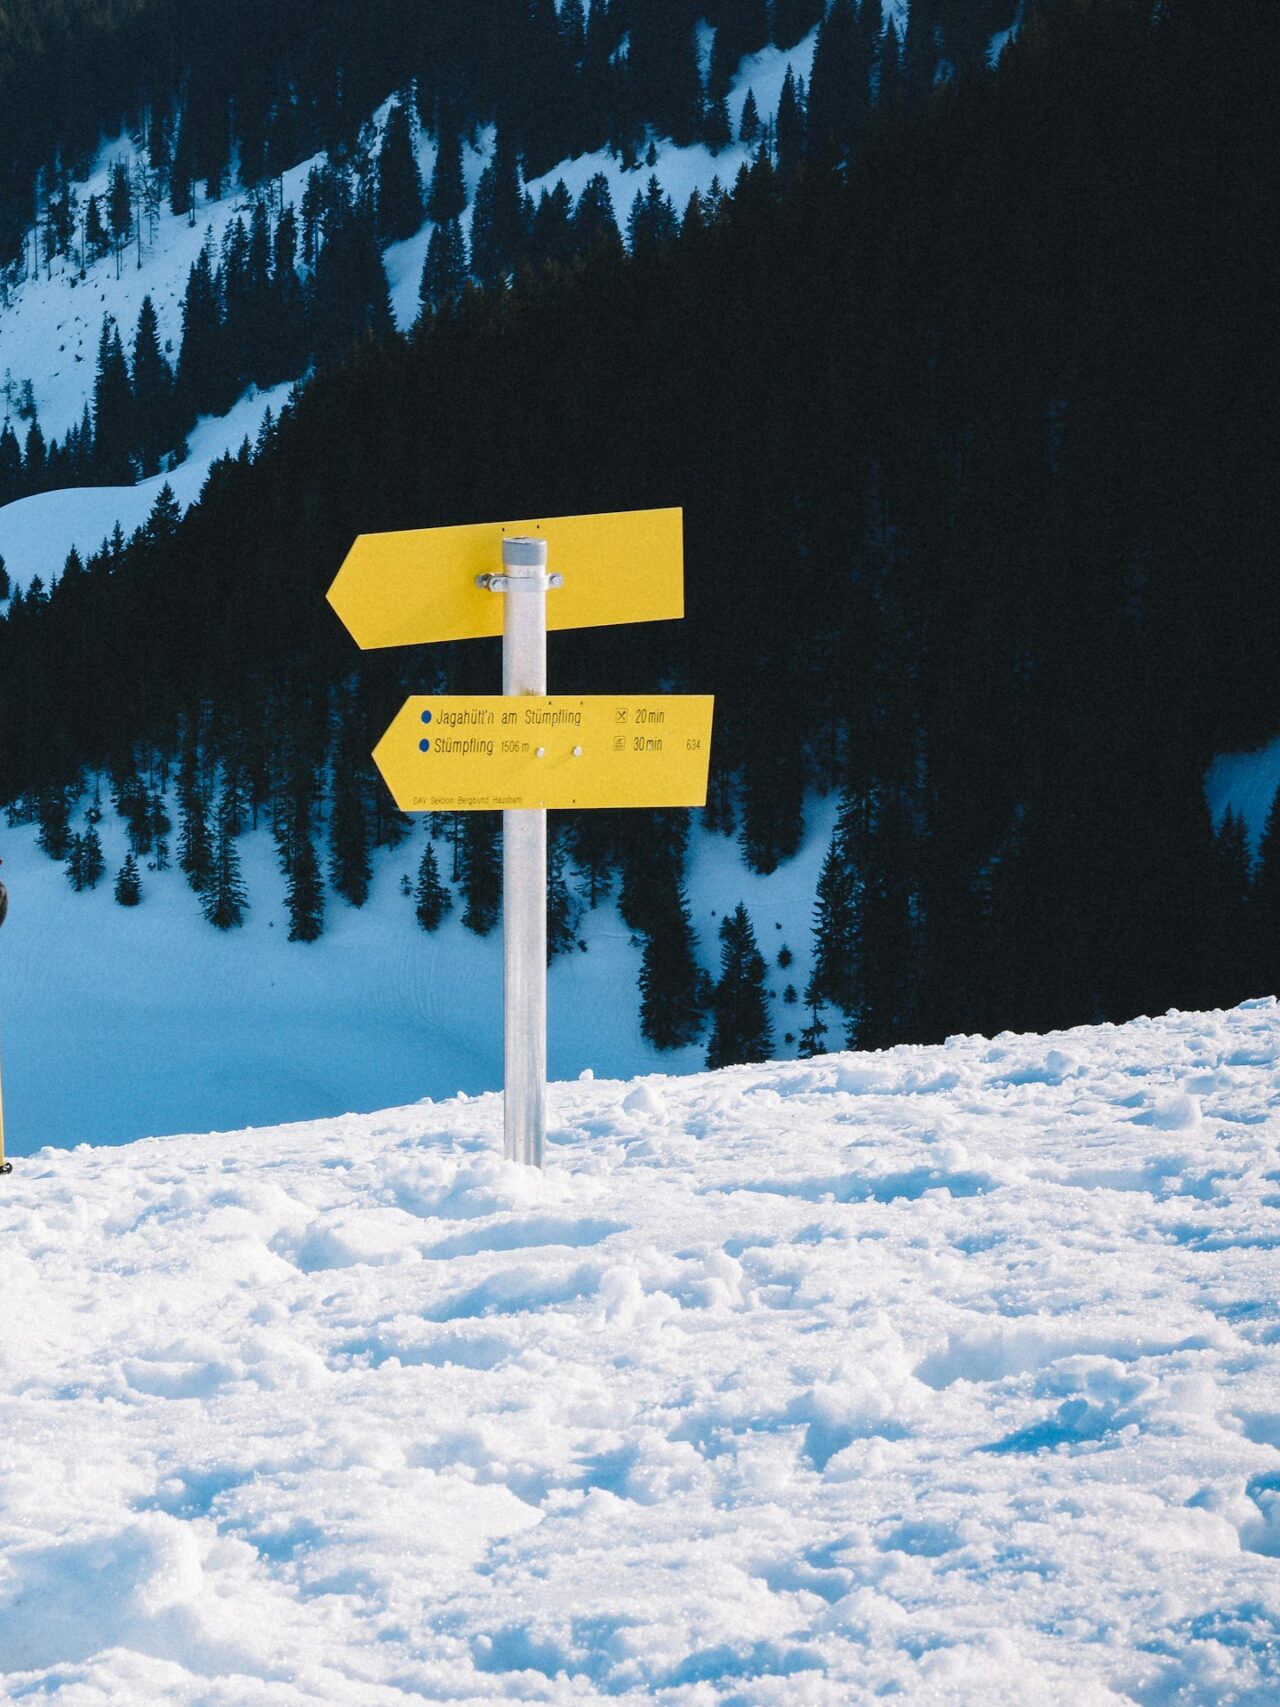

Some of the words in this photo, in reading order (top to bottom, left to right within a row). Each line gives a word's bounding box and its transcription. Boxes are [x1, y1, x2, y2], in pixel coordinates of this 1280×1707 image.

[501, 713, 517, 725] am
[525, 709, 581, 727] Stümpfling
[635, 709, 647, 724] 20
[434, 738, 493, 756] Stümpfling
[501, 740, 520, 753] 1506
[633, 736, 645, 752] 30
[686, 739, 700, 750] 634
